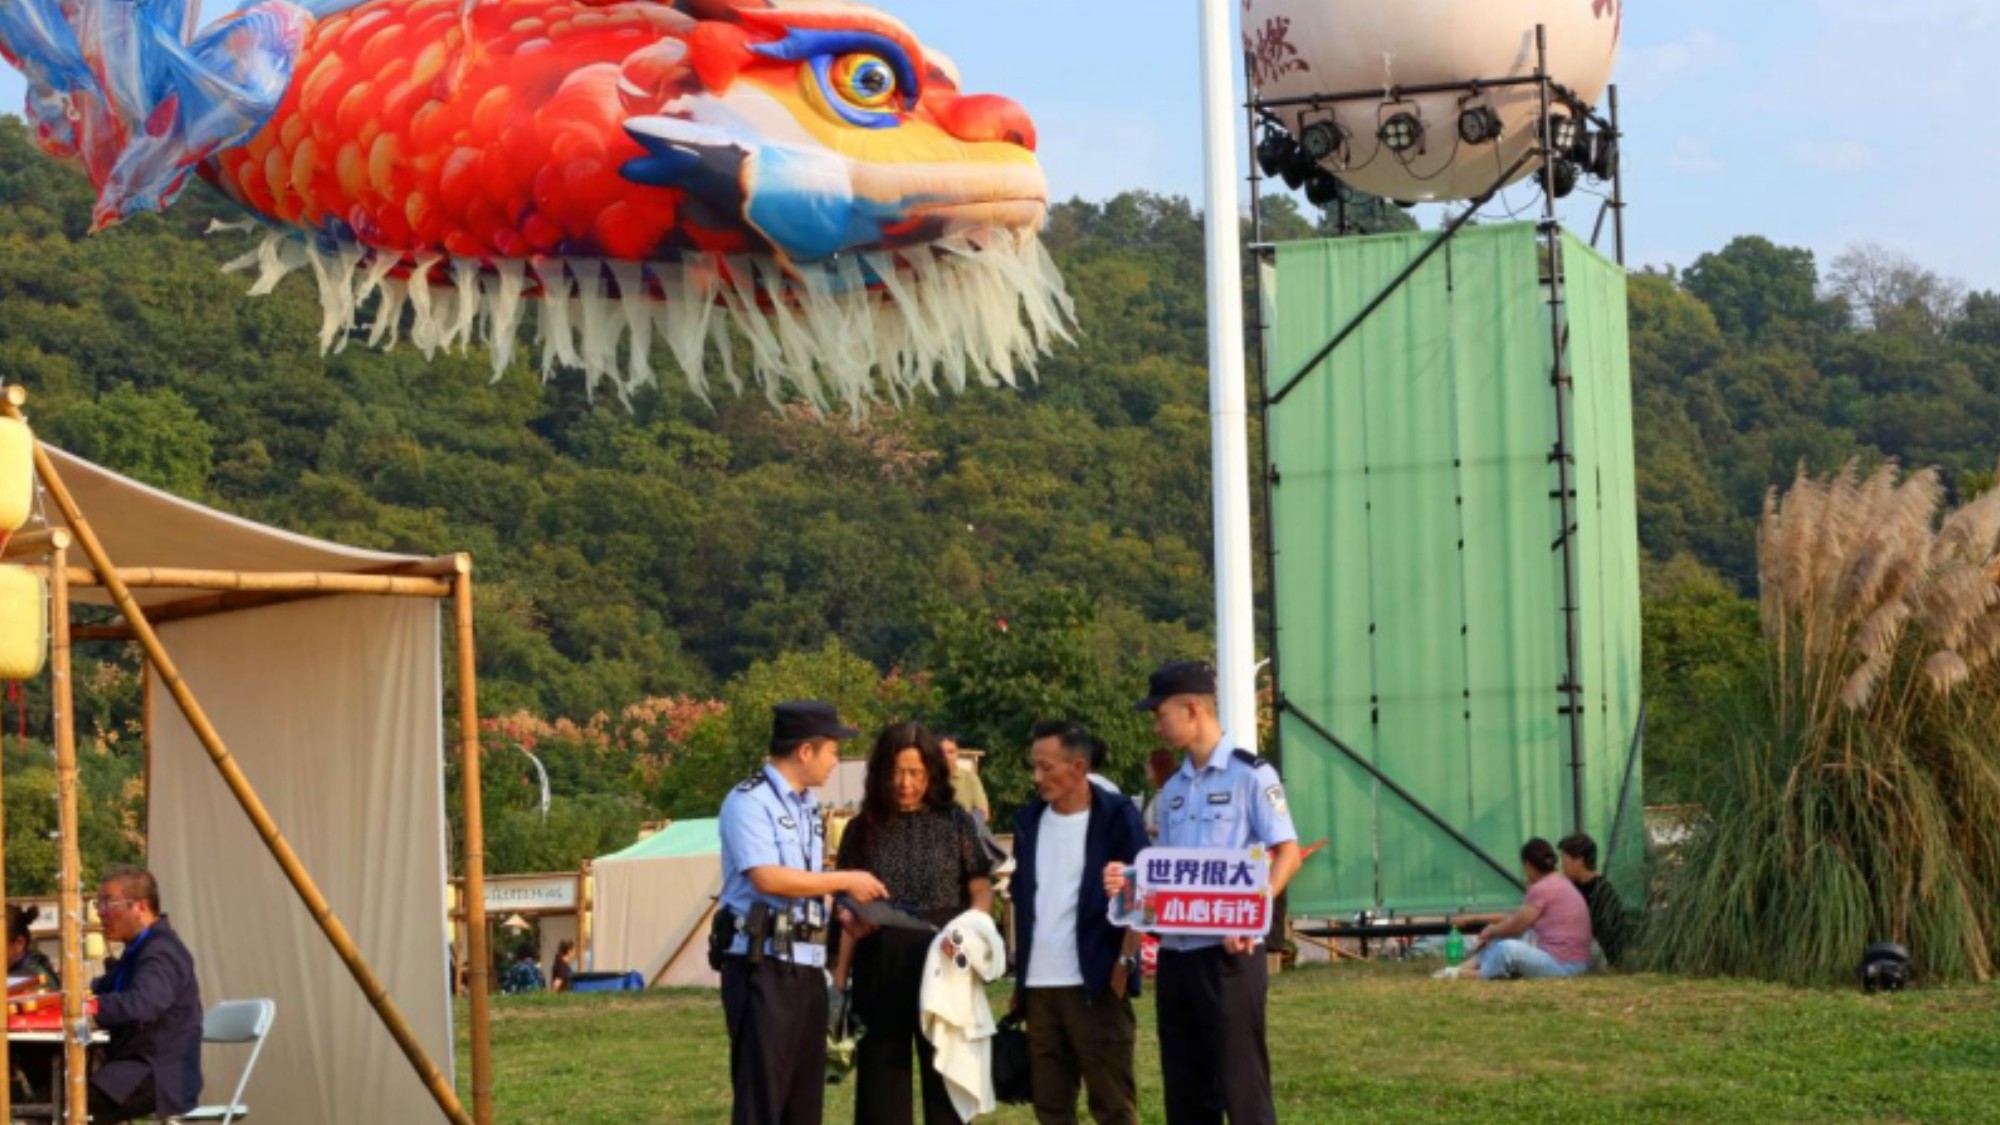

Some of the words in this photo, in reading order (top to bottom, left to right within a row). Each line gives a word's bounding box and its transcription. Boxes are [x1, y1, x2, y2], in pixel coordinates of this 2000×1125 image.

[1147, 859, 1255, 886] 世界很大
[1162, 898, 1261, 924] 小心有诈
